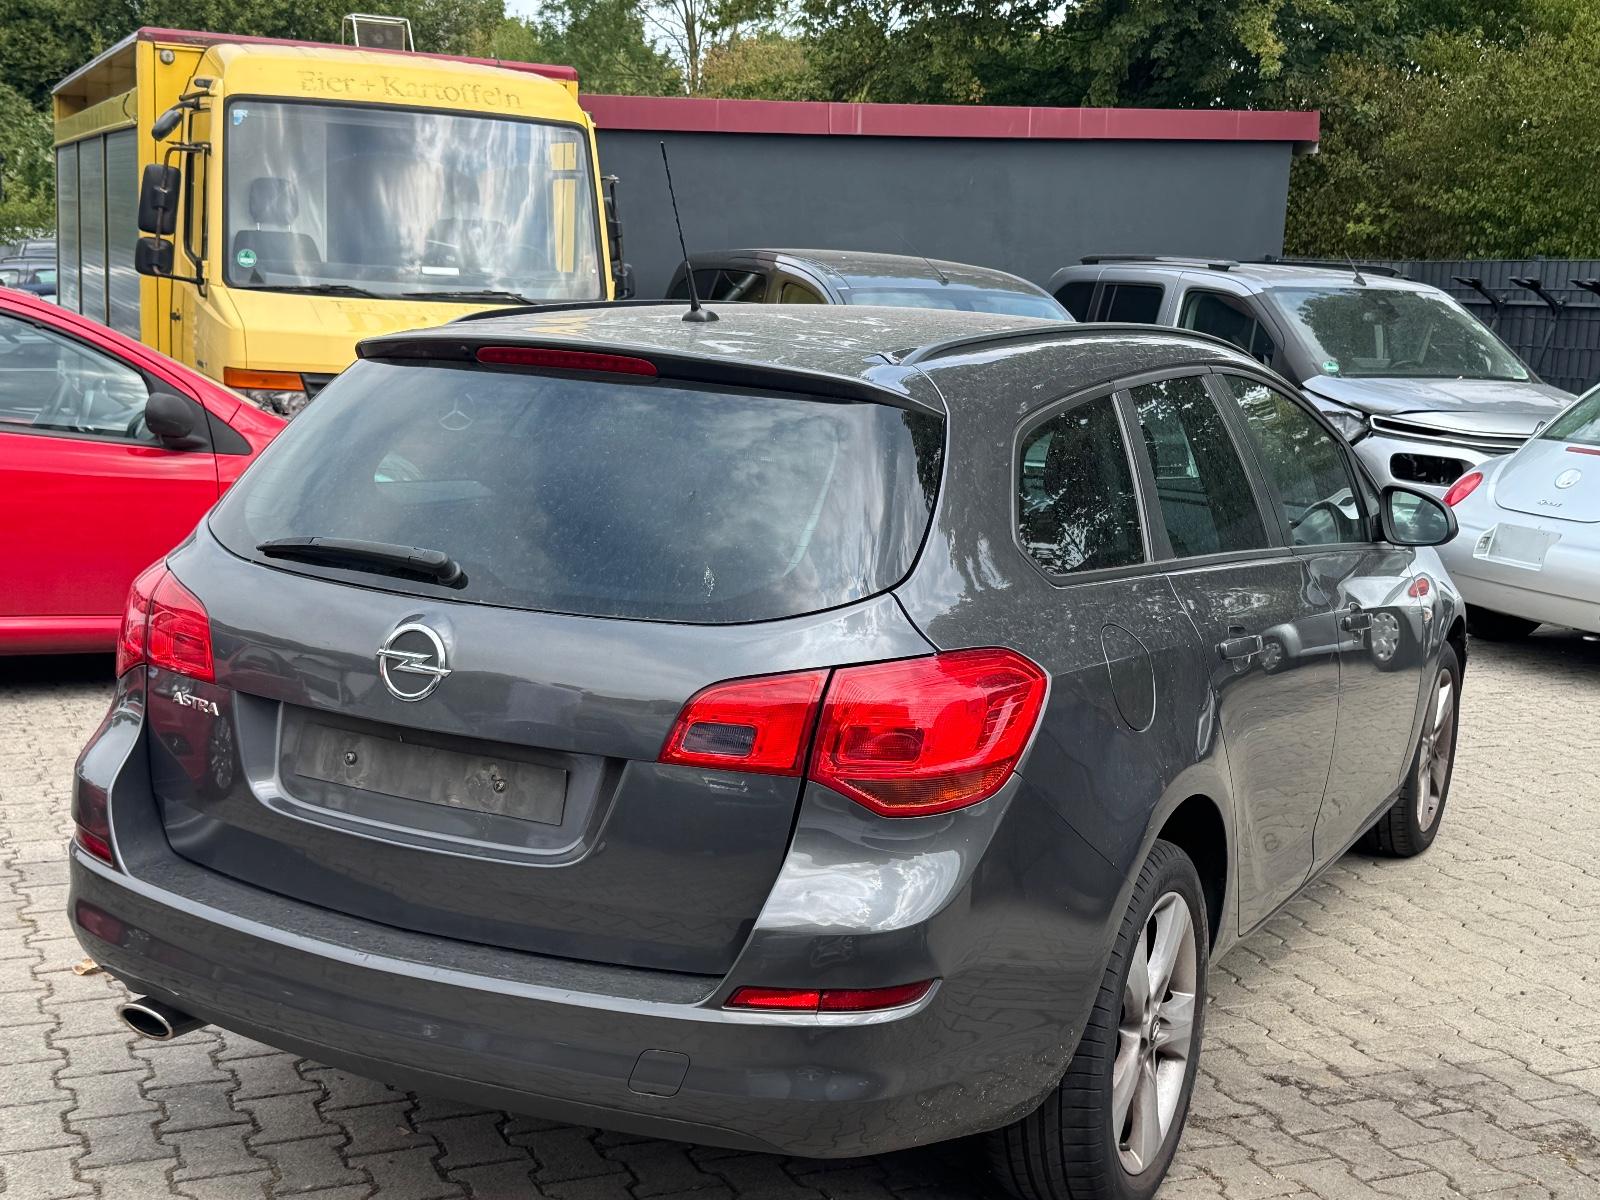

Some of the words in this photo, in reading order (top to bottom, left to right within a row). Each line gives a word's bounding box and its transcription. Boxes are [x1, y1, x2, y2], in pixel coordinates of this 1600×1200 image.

[297, 70, 355, 93] Eier
[361, 79, 376, 93] +
[172, 691, 220, 717] ASTRA
